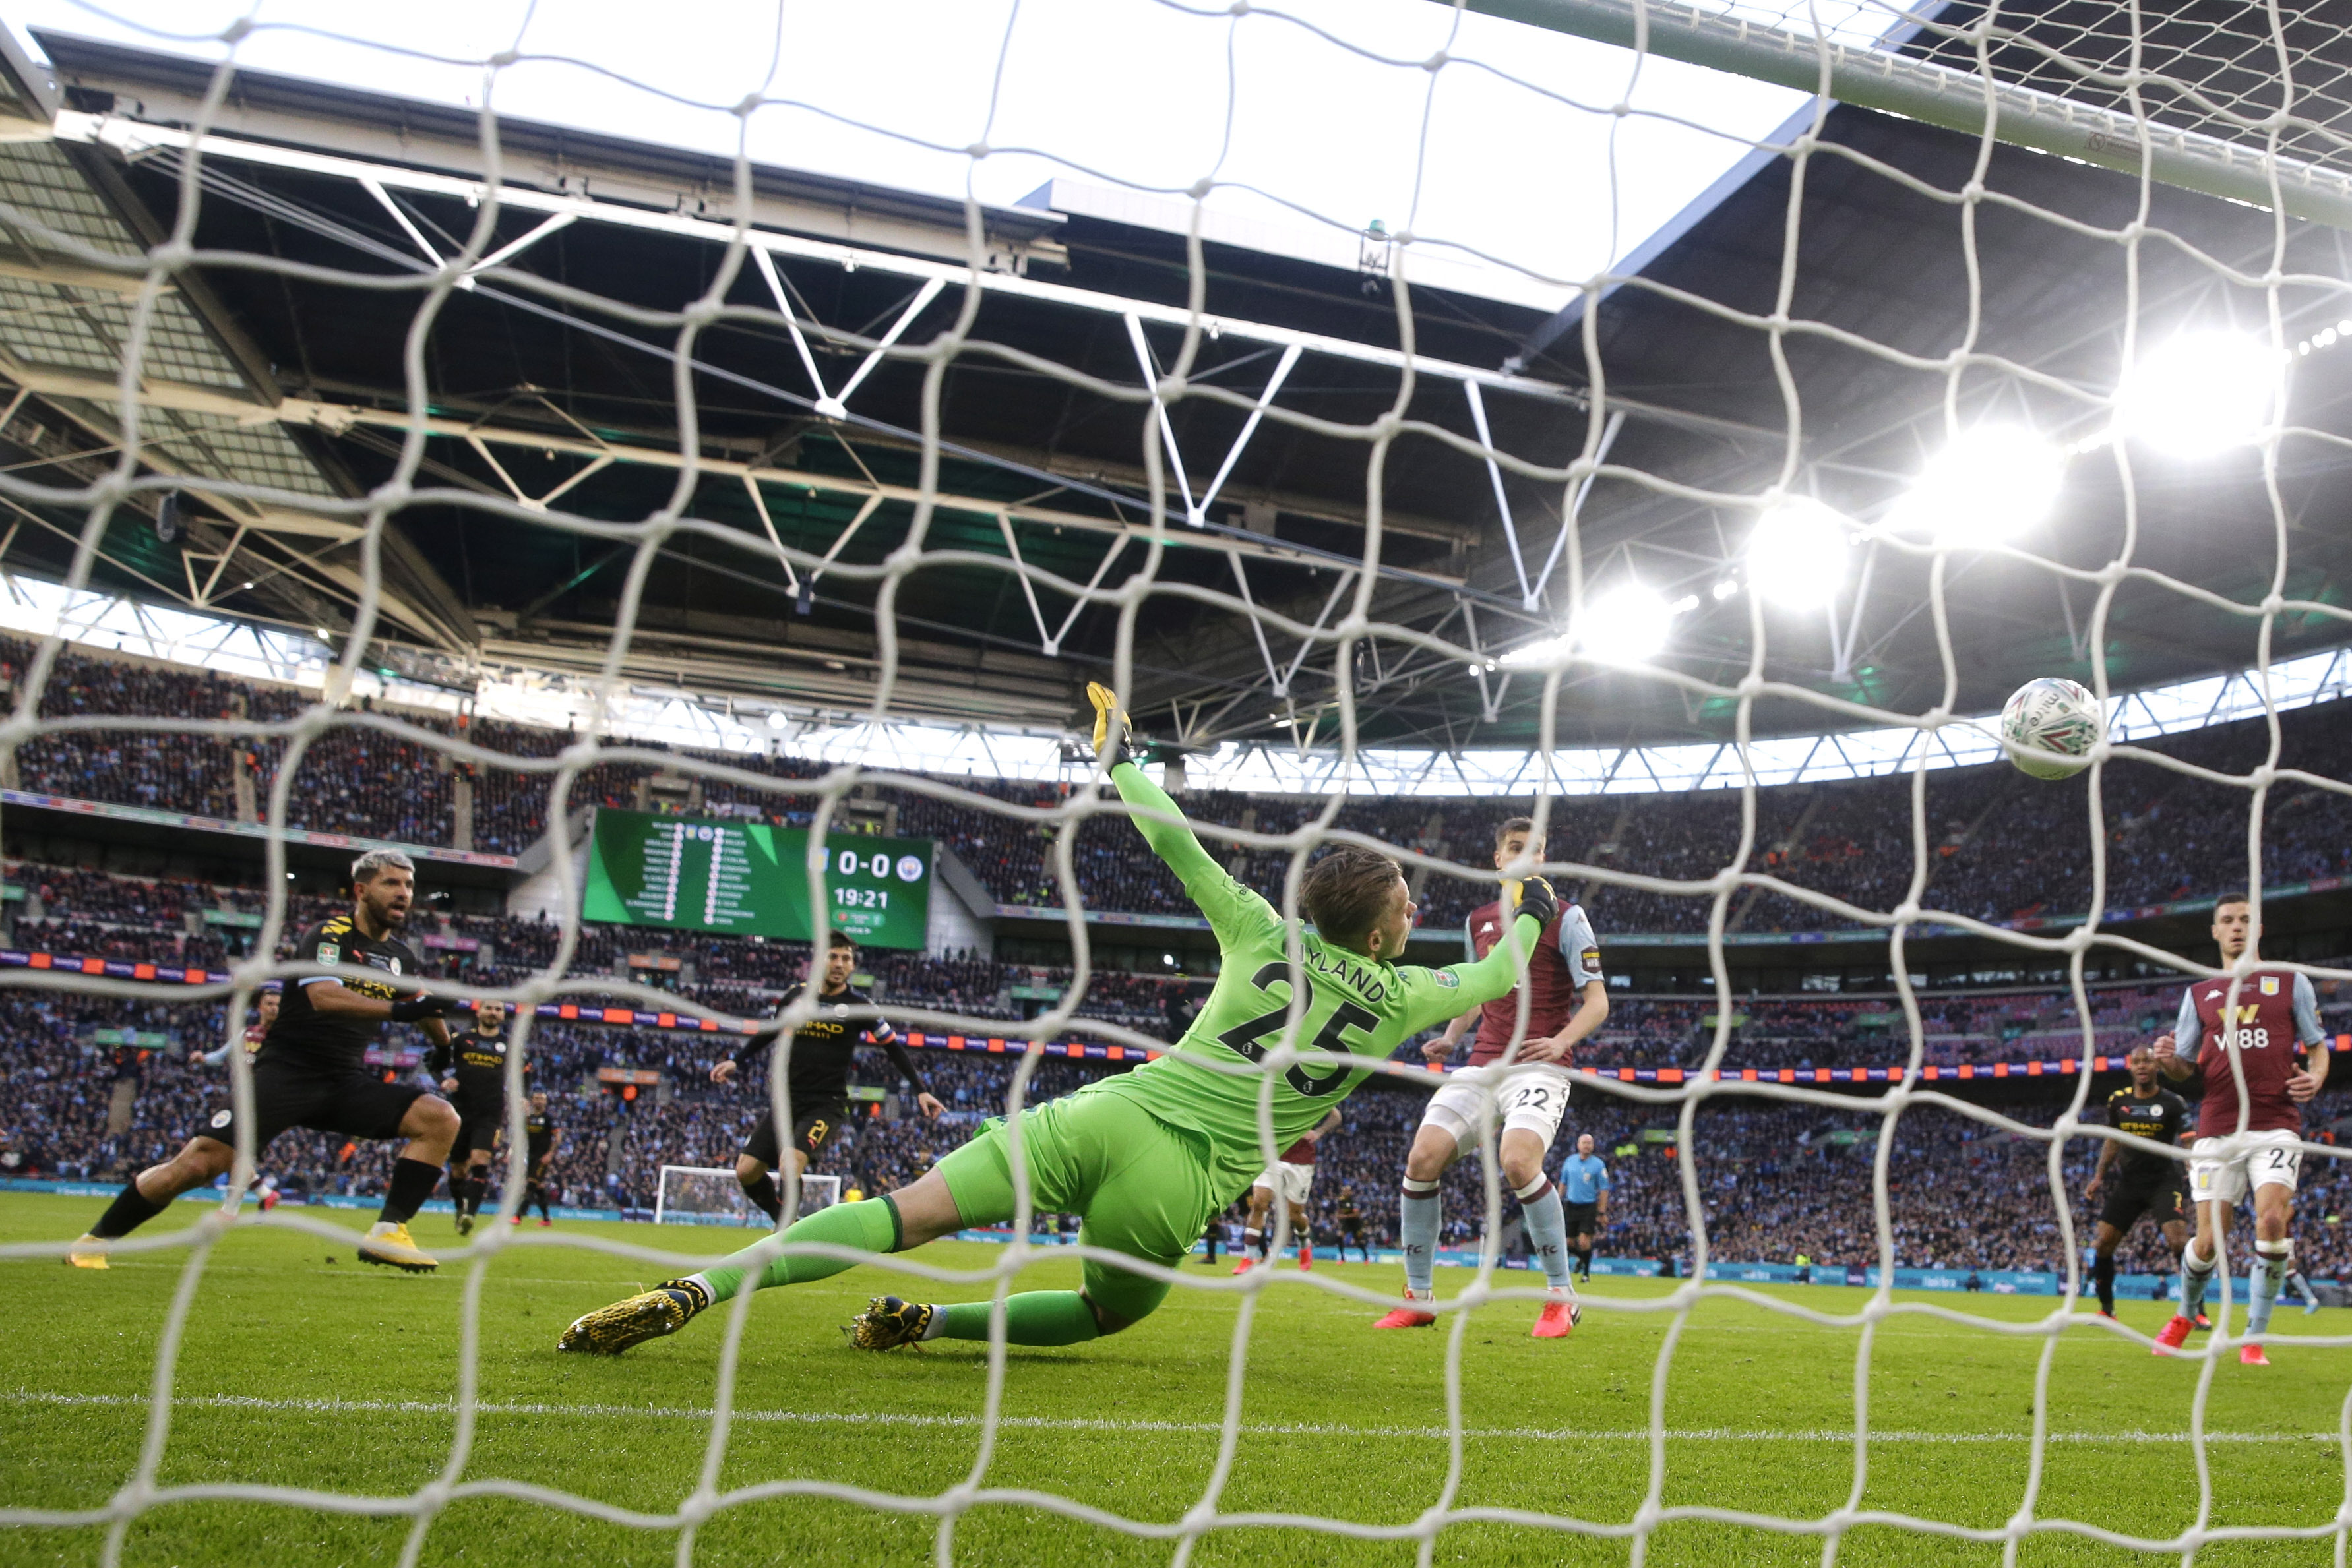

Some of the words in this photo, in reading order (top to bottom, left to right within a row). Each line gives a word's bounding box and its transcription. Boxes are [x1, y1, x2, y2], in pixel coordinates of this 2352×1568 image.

[838, 850, 890, 878] 0-0
[834, 887, 888, 909] 19:21
[1216, 961, 1382, 1097] 25
[2212, 1027, 2270, 1052] W88
[1515, 1087, 1550, 1112] 22
